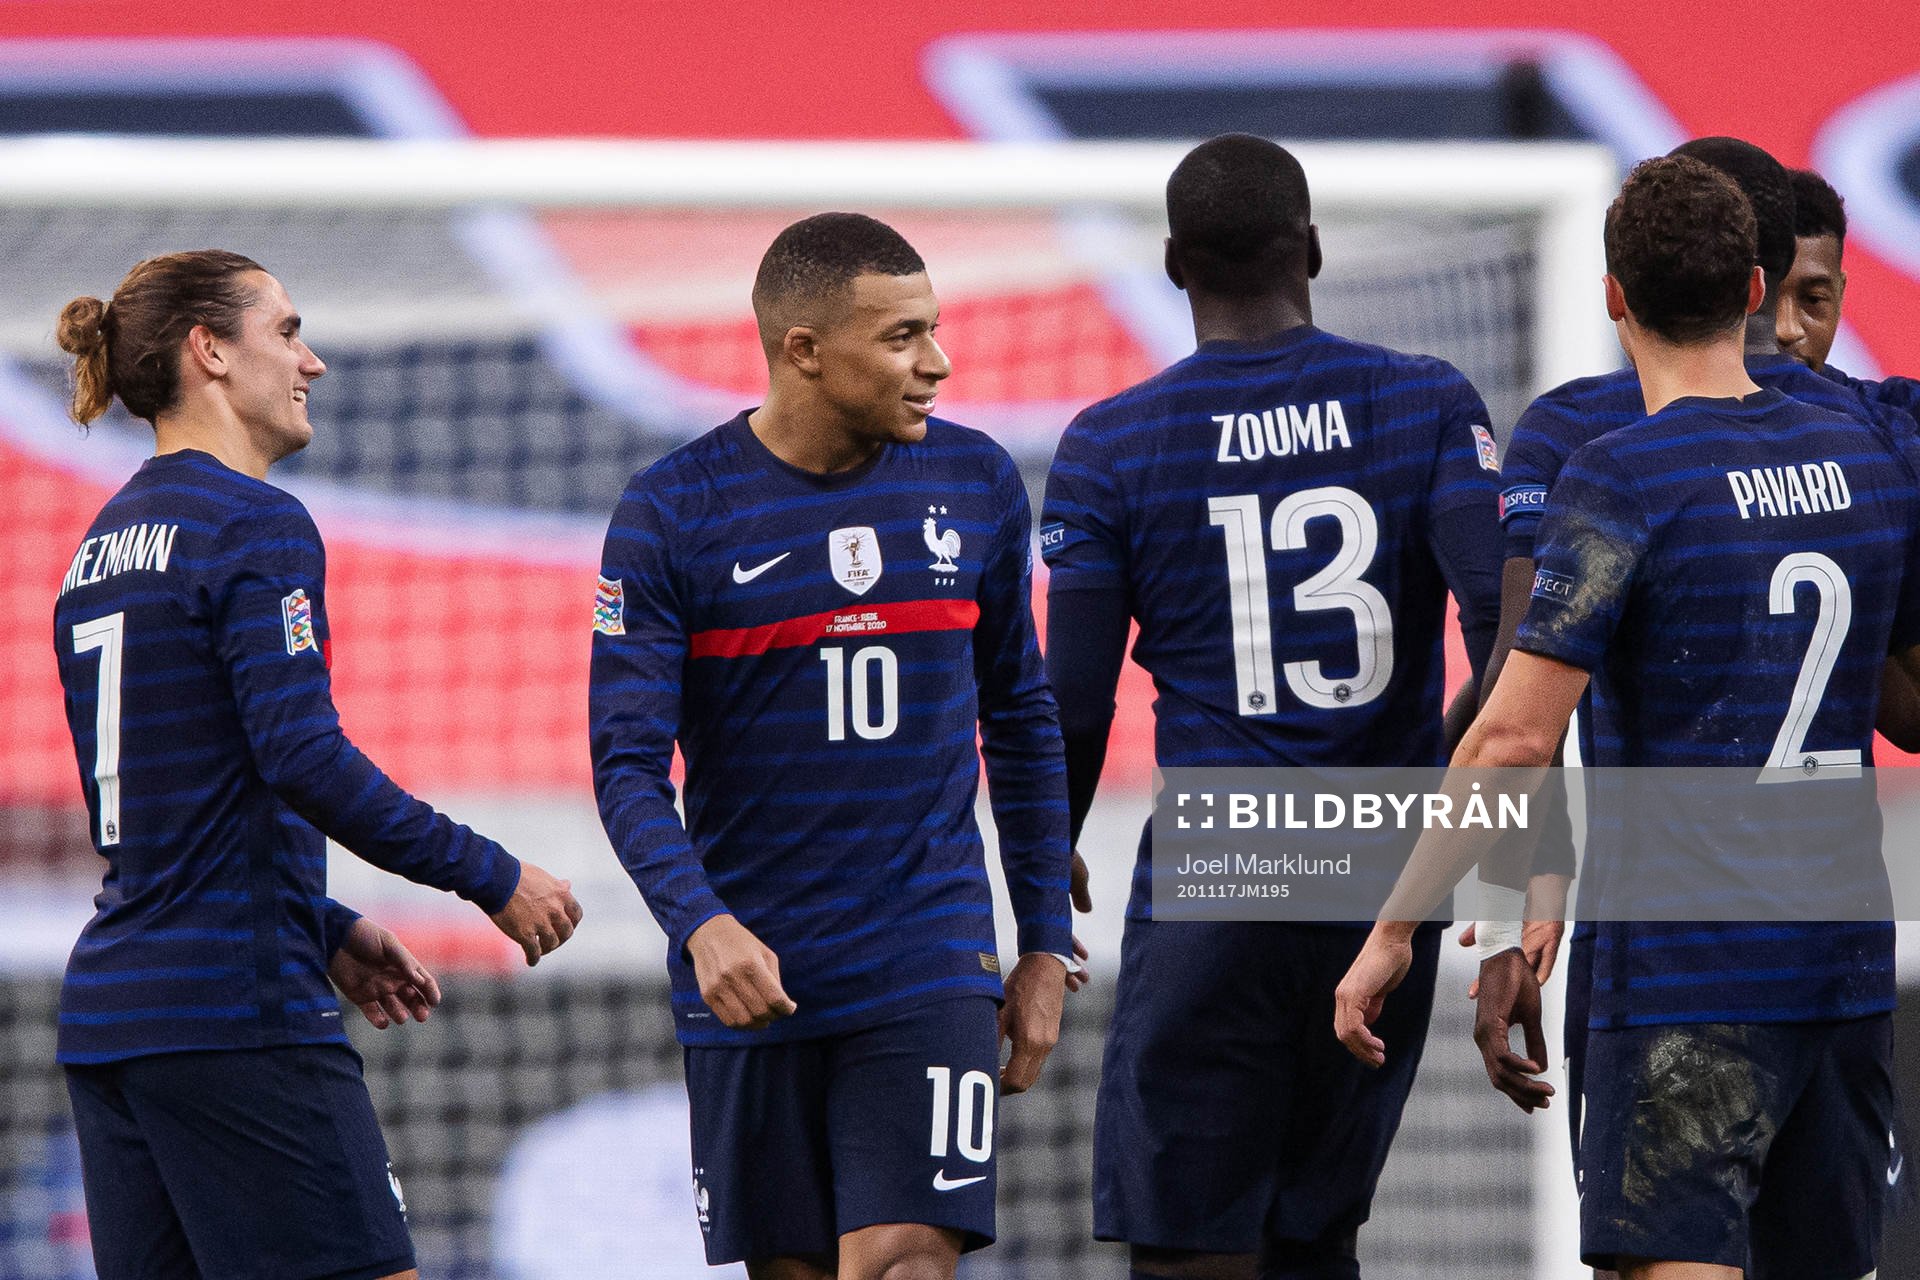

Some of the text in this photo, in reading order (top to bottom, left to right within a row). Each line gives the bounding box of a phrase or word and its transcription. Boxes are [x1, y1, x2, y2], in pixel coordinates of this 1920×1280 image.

[1211, 400, 1352, 463] ZOUMA
[1726, 461, 1853, 520] PAVARD
[56, 523, 179, 601] IEZMANN
[1040, 528, 1065, 548] PECT
[847, 569, 870, 578] FIFA
[1207, 485, 1394, 716] 13
[834, 614, 857, 623] FRANCE
[867, 620, 887, 630] 2020
[820, 646, 899, 741] 10
[1755, 551, 1863, 785] 2
[72, 611, 125, 847] 7
[926, 1066, 994, 1163] 10
